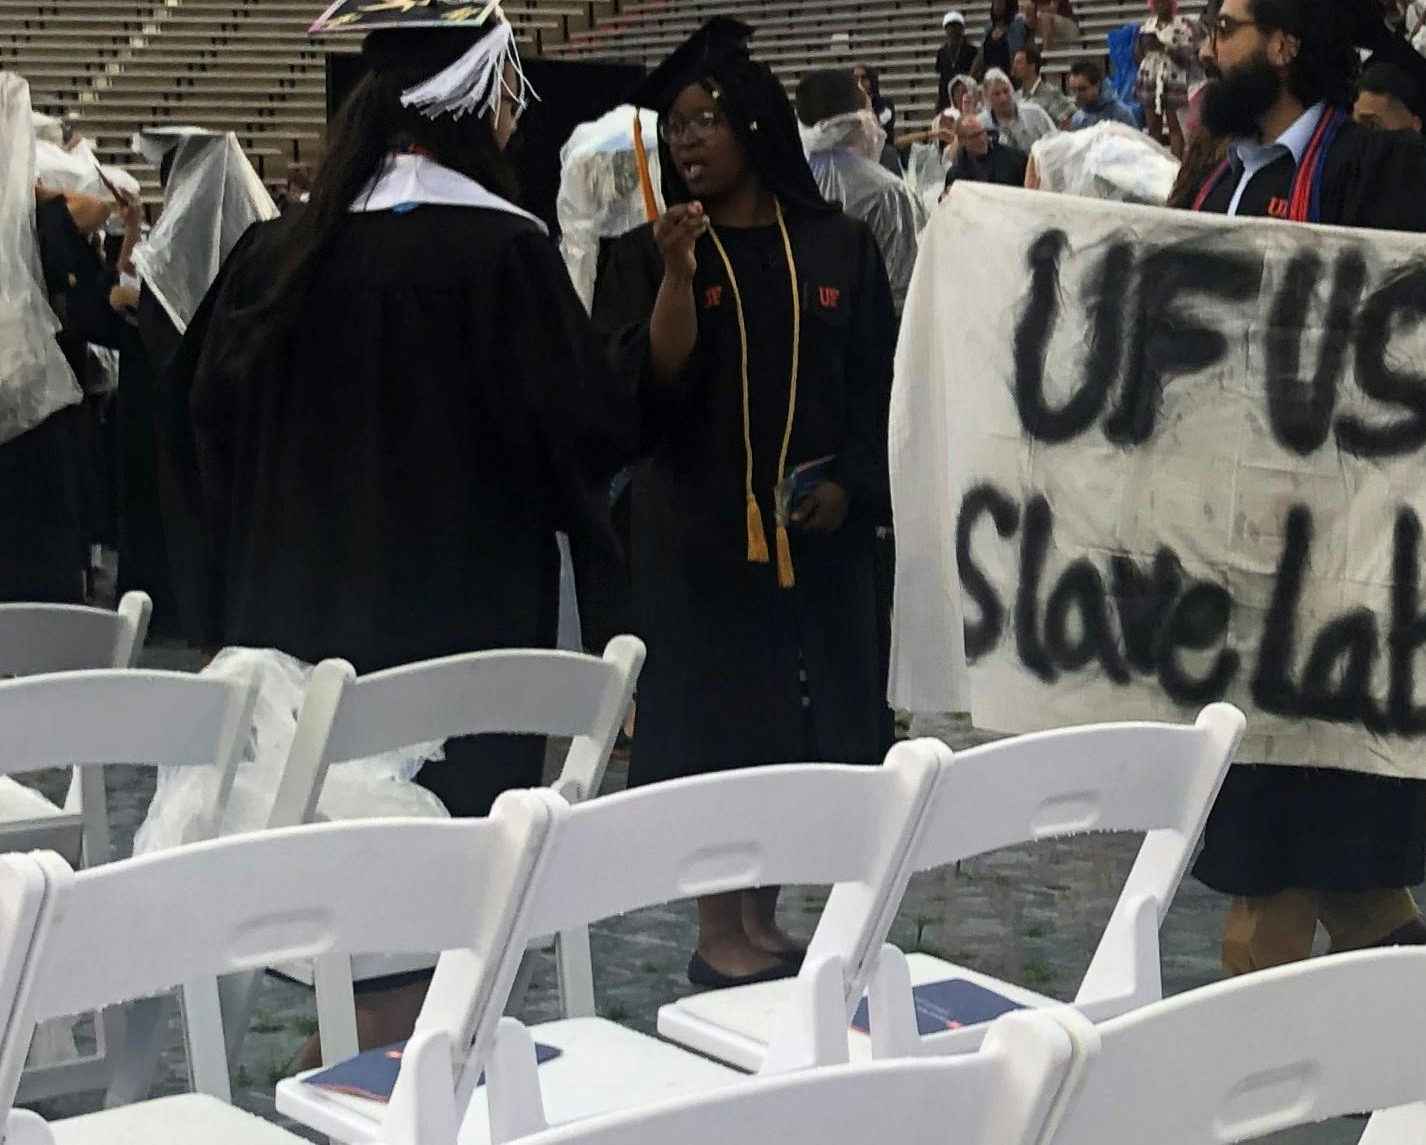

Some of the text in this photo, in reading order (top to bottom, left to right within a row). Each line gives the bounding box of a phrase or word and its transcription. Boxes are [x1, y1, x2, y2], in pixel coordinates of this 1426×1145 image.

[818, 285, 840, 308] UF
[1012, 227, 1263, 445] UF
[955, 482, 1242, 706] Slave
